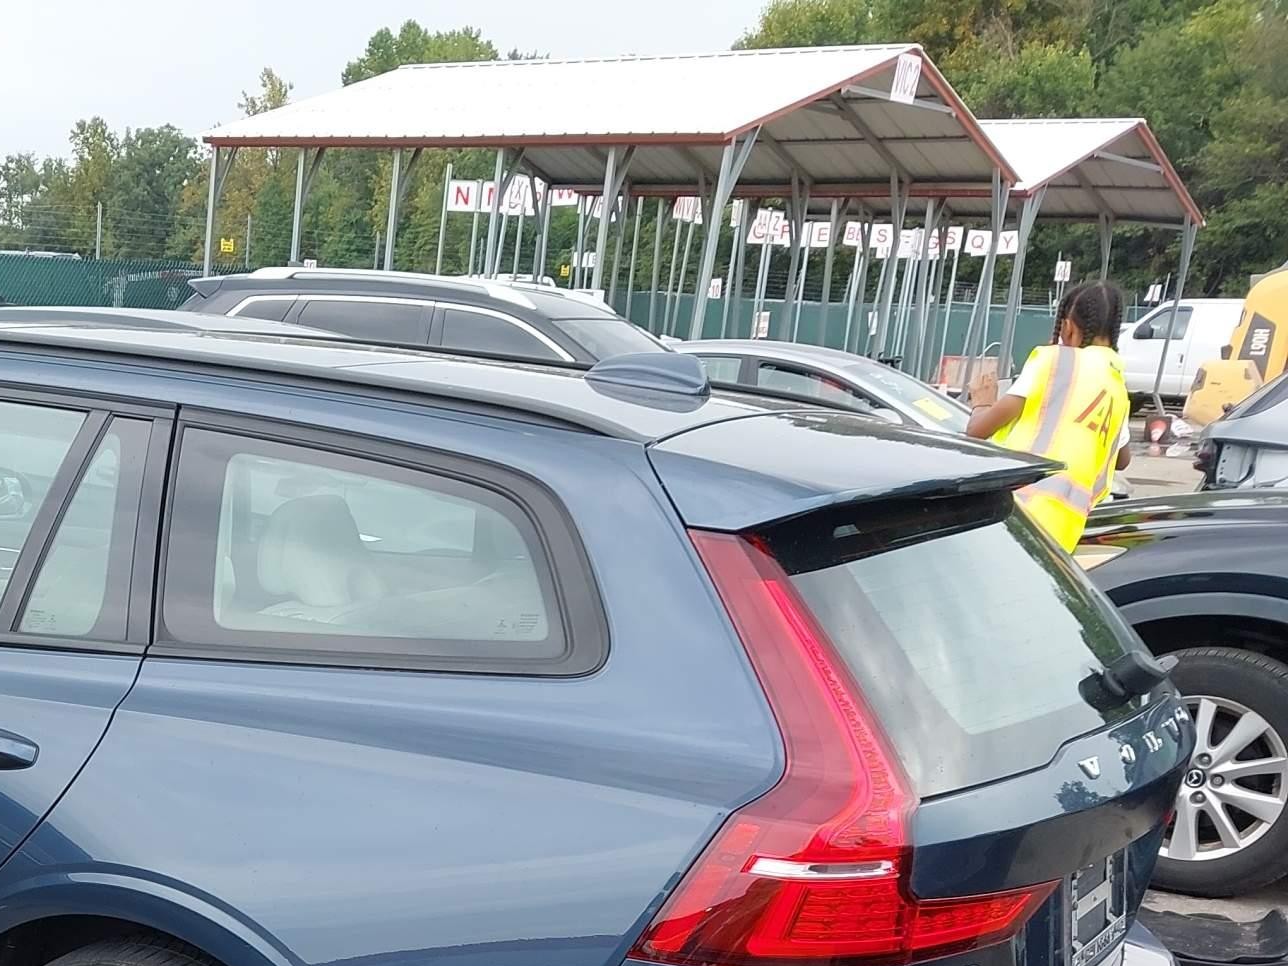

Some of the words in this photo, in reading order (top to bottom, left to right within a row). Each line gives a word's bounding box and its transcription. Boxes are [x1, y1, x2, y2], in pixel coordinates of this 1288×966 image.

[455, 186, 470, 206] N
[817, 227, 829, 242] E
[876, 228, 888, 243] S
[971, 234, 985, 249] Q
[1002, 235, 1014, 249] Y
[1249, 328, 1271, 356] L90H
